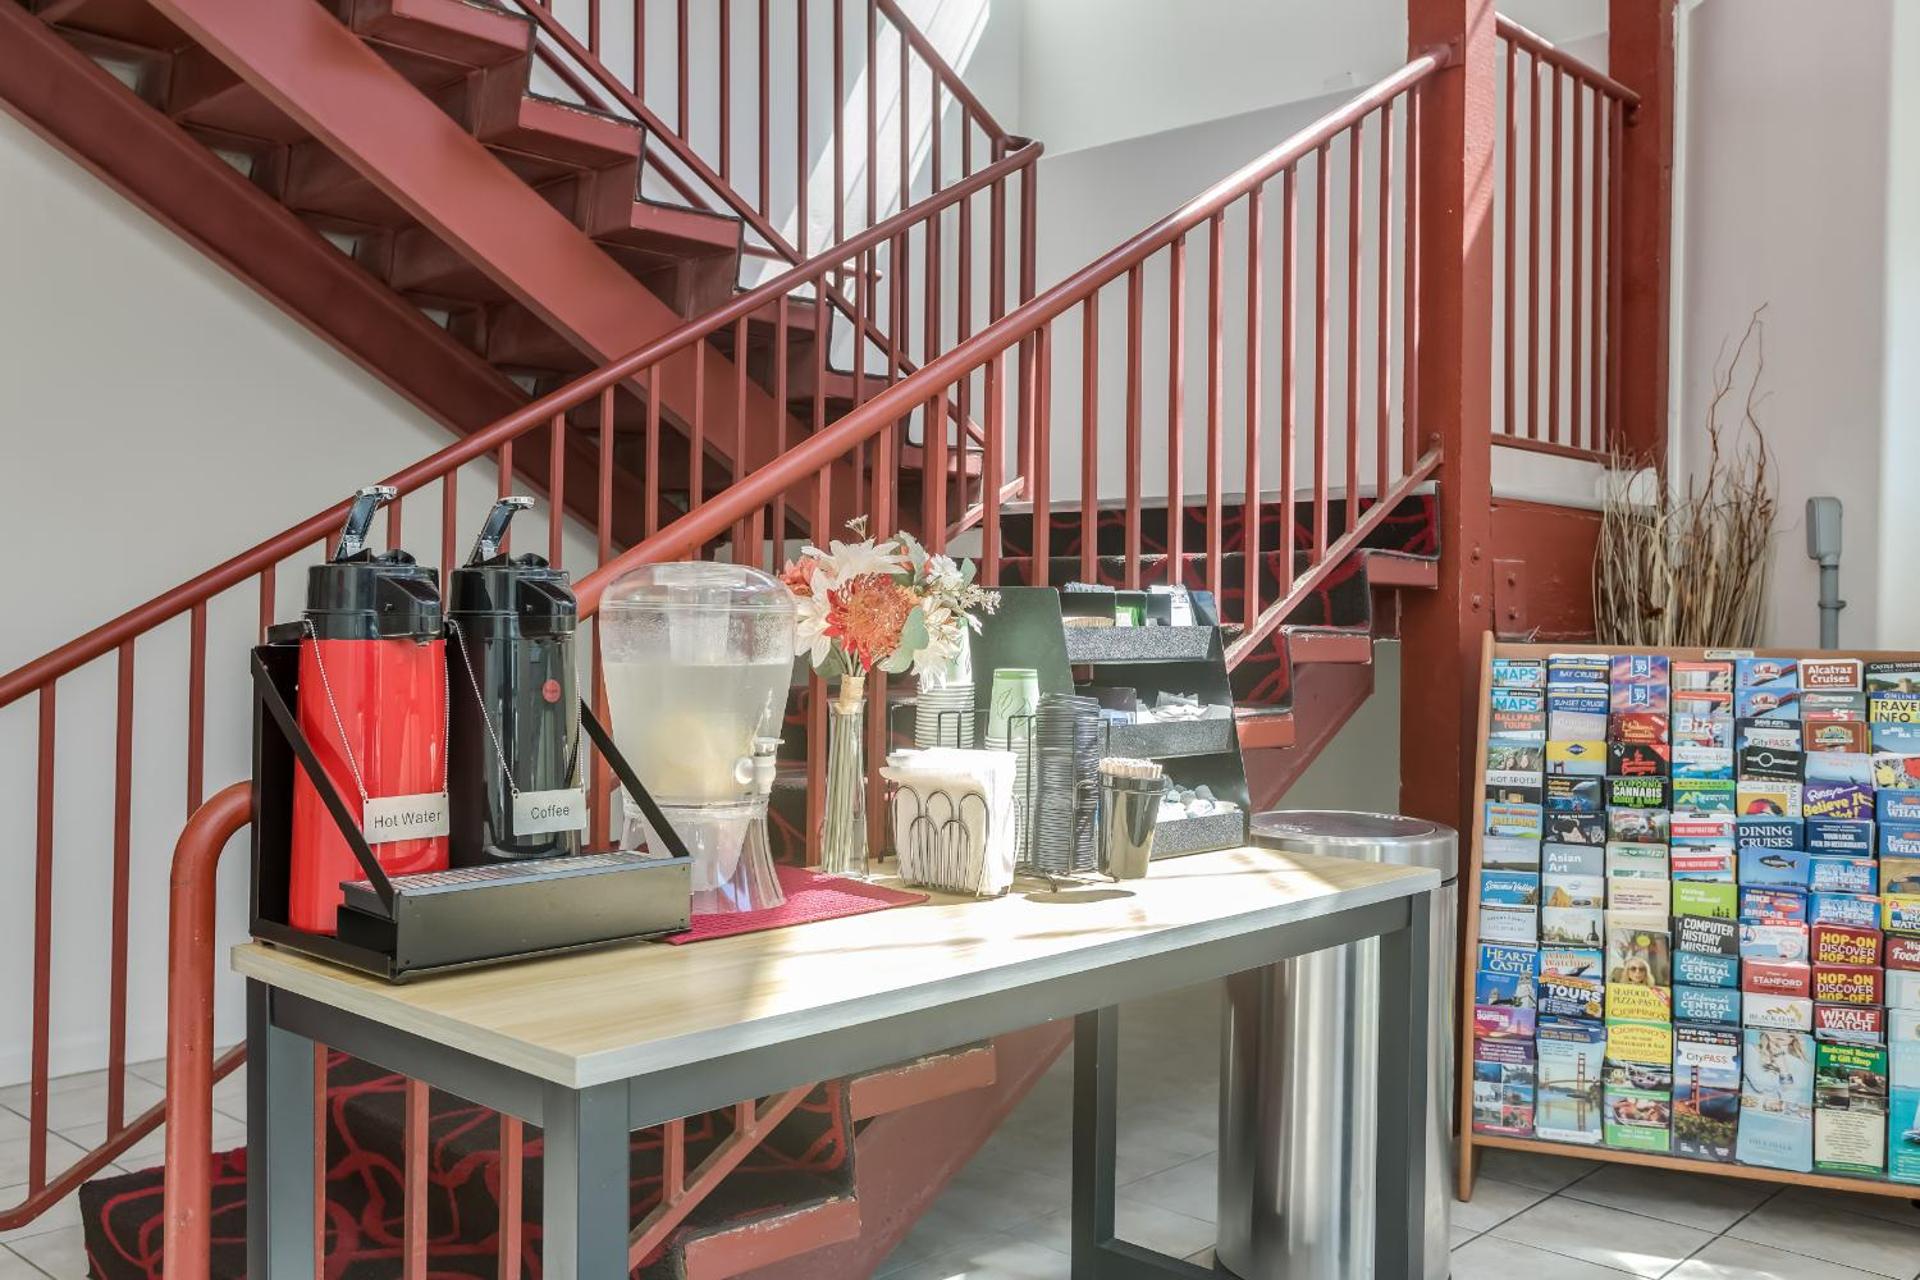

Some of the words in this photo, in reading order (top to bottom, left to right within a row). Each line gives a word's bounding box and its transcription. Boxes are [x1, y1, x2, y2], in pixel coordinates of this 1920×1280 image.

[1495, 668, 1538, 680] MAPS
[1636, 664, 1647, 673] 39
[1808, 665, 1852, 674] Alcatraz
[1810, 674, 1850, 684] Cruises
[1634, 692, 1646, 701] 39
[1495, 699, 1538, 711] MAPS
[1554, 699, 1578, 707] SUNSET
[1873, 701, 1920, 711] TRAVE
[1874, 712, 1911, 723] INFO
[1504, 721, 1532, 730] TOURS
[1680, 718, 1722, 735] Bike
[1751, 738, 1792, 747] CityPASS
[1490, 776, 1507, 784] HOT
[1613, 779, 1664, 788] CALIFORNIA
[1613, 787, 1663, 797] CANNABIS
[530, 805, 570, 820] Coffee
[1804, 798, 1849, 817] Believe
[374, 815, 398, 829] Hot
[402, 811, 441, 826] Water
[1740, 826, 1793, 836] DINING
[1740, 838, 1793, 848] CRUISES
[1548, 853, 1582, 863] Asian
[1548, 863, 1568, 873] Art
[1744, 908, 1784, 919] BRIDGE
[1684, 918, 1734, 937] COMPUTER
[1682, 929, 1722, 946] HISTORY
[1821, 932, 1877, 948] HOP-ON
[1681, 940, 1722, 954] MUSEUM
[1820, 943, 1876, 957] DISCOVER
[1487, 948, 1536, 963] HEARST
[1819, 952, 1875, 964] HOP-OFF
[1490, 960, 1533, 973] CASTLE
[1680, 964, 1730, 977] CENTRAL
[1686, 973, 1724, 984] COAST
[1752, 975, 1803, 987] STANFORD
[1817, 973, 1873, 985] HOP-ON
[1817, 983, 1873, 994] DISCOVER
[1682, 991, 1729, 1003] California's
[1818, 992, 1873, 1004] HOP-OFF
[1680, 1000, 1731, 1012] CENTRAL
[1687, 1009, 1724, 1019] COAST
[1821, 1010, 1876, 1024] WHALE
[1825, 1020, 1872, 1031] WATCH
[1686, 1053, 1727, 1064] CityPASS
